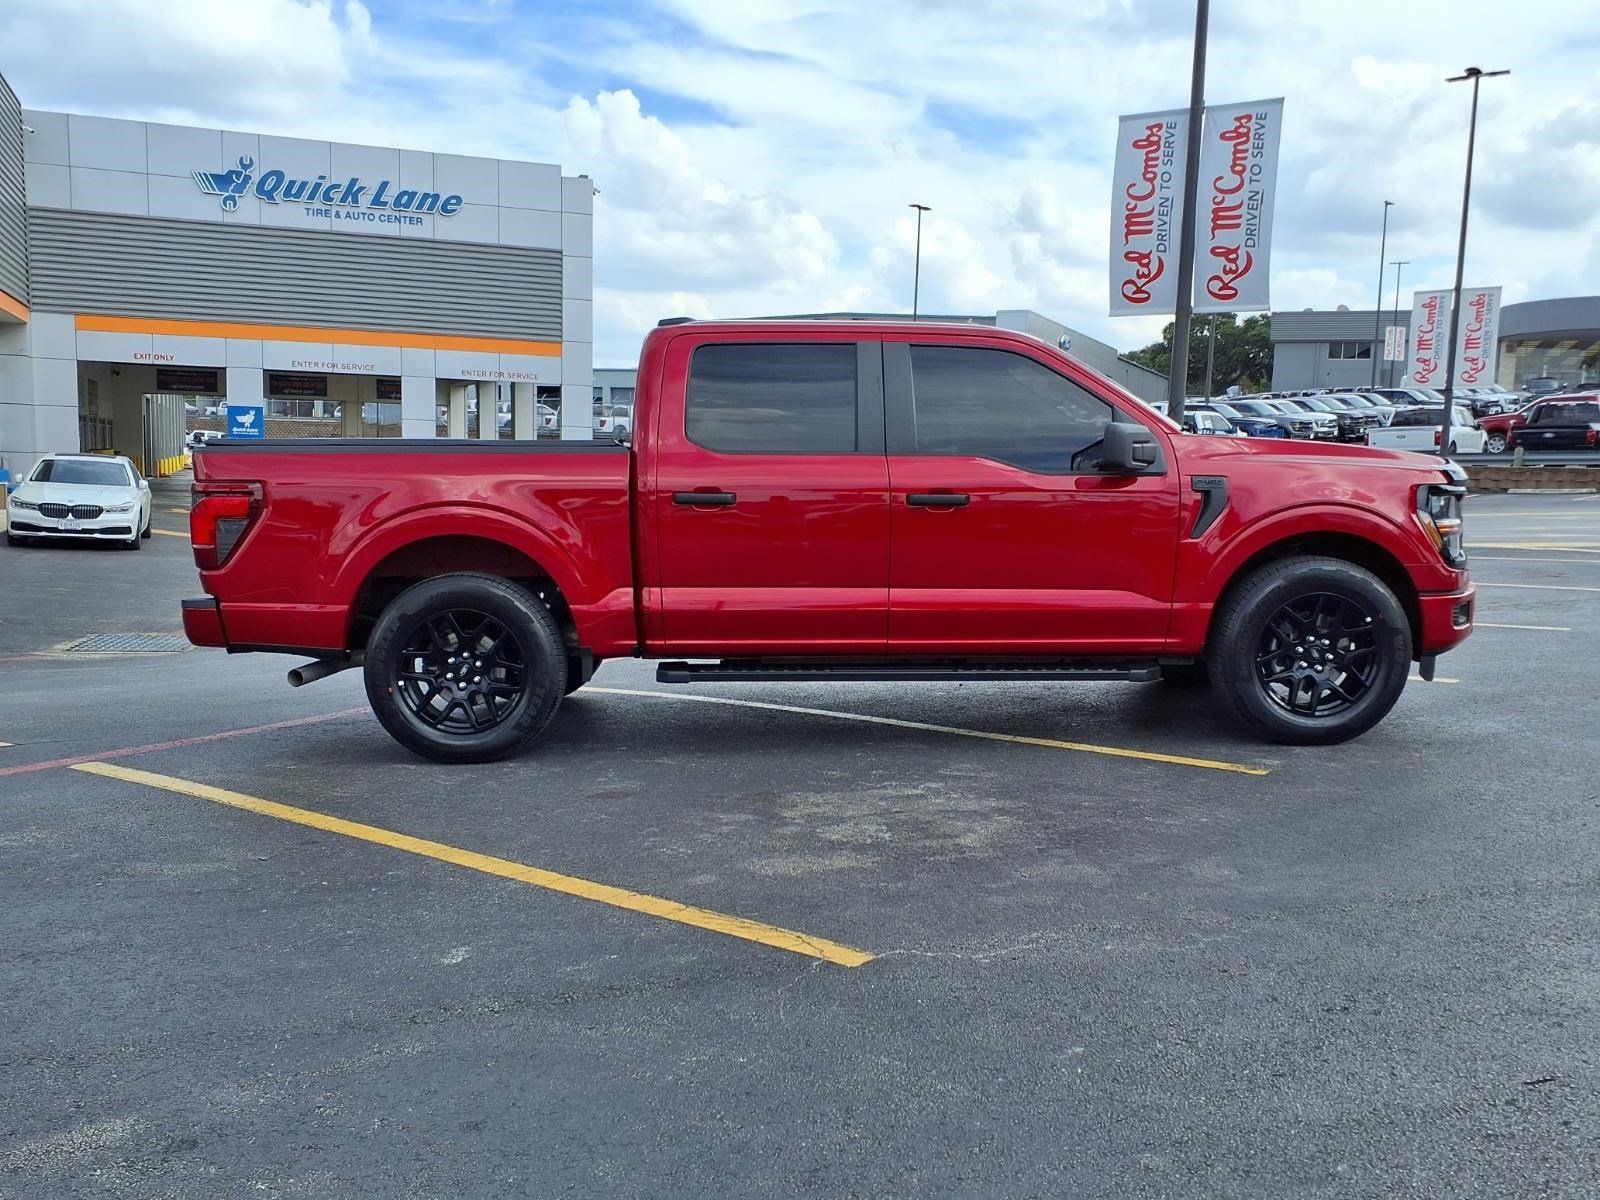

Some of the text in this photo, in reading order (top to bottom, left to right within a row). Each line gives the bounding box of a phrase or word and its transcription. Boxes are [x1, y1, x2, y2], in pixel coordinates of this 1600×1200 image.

[255, 169, 463, 216] Quick Lane
[1121, 122, 1165, 304] Red McCombs
[1156, 121, 1177, 253] DRIVEN TO SERVE
[1206, 113, 1253, 300] Red McCombs
[1245, 112, 1268, 248] DRIVEN TO SERVE
[304, 207, 424, 226] TIRE & AUTO CENTER
[1413, 296, 1438, 384] Red McCombs
[1433, 332, 1443, 360] DRIVEN
[1436, 320, 1443, 329] TO
[1460, 293, 1487, 383] Red McCombs
[291, 360, 319, 369] ENTER
[341, 363, 377, 371] SERVICE
[461, 369, 488, 377] ENTER
[506, 372, 540, 380] SERVICE
